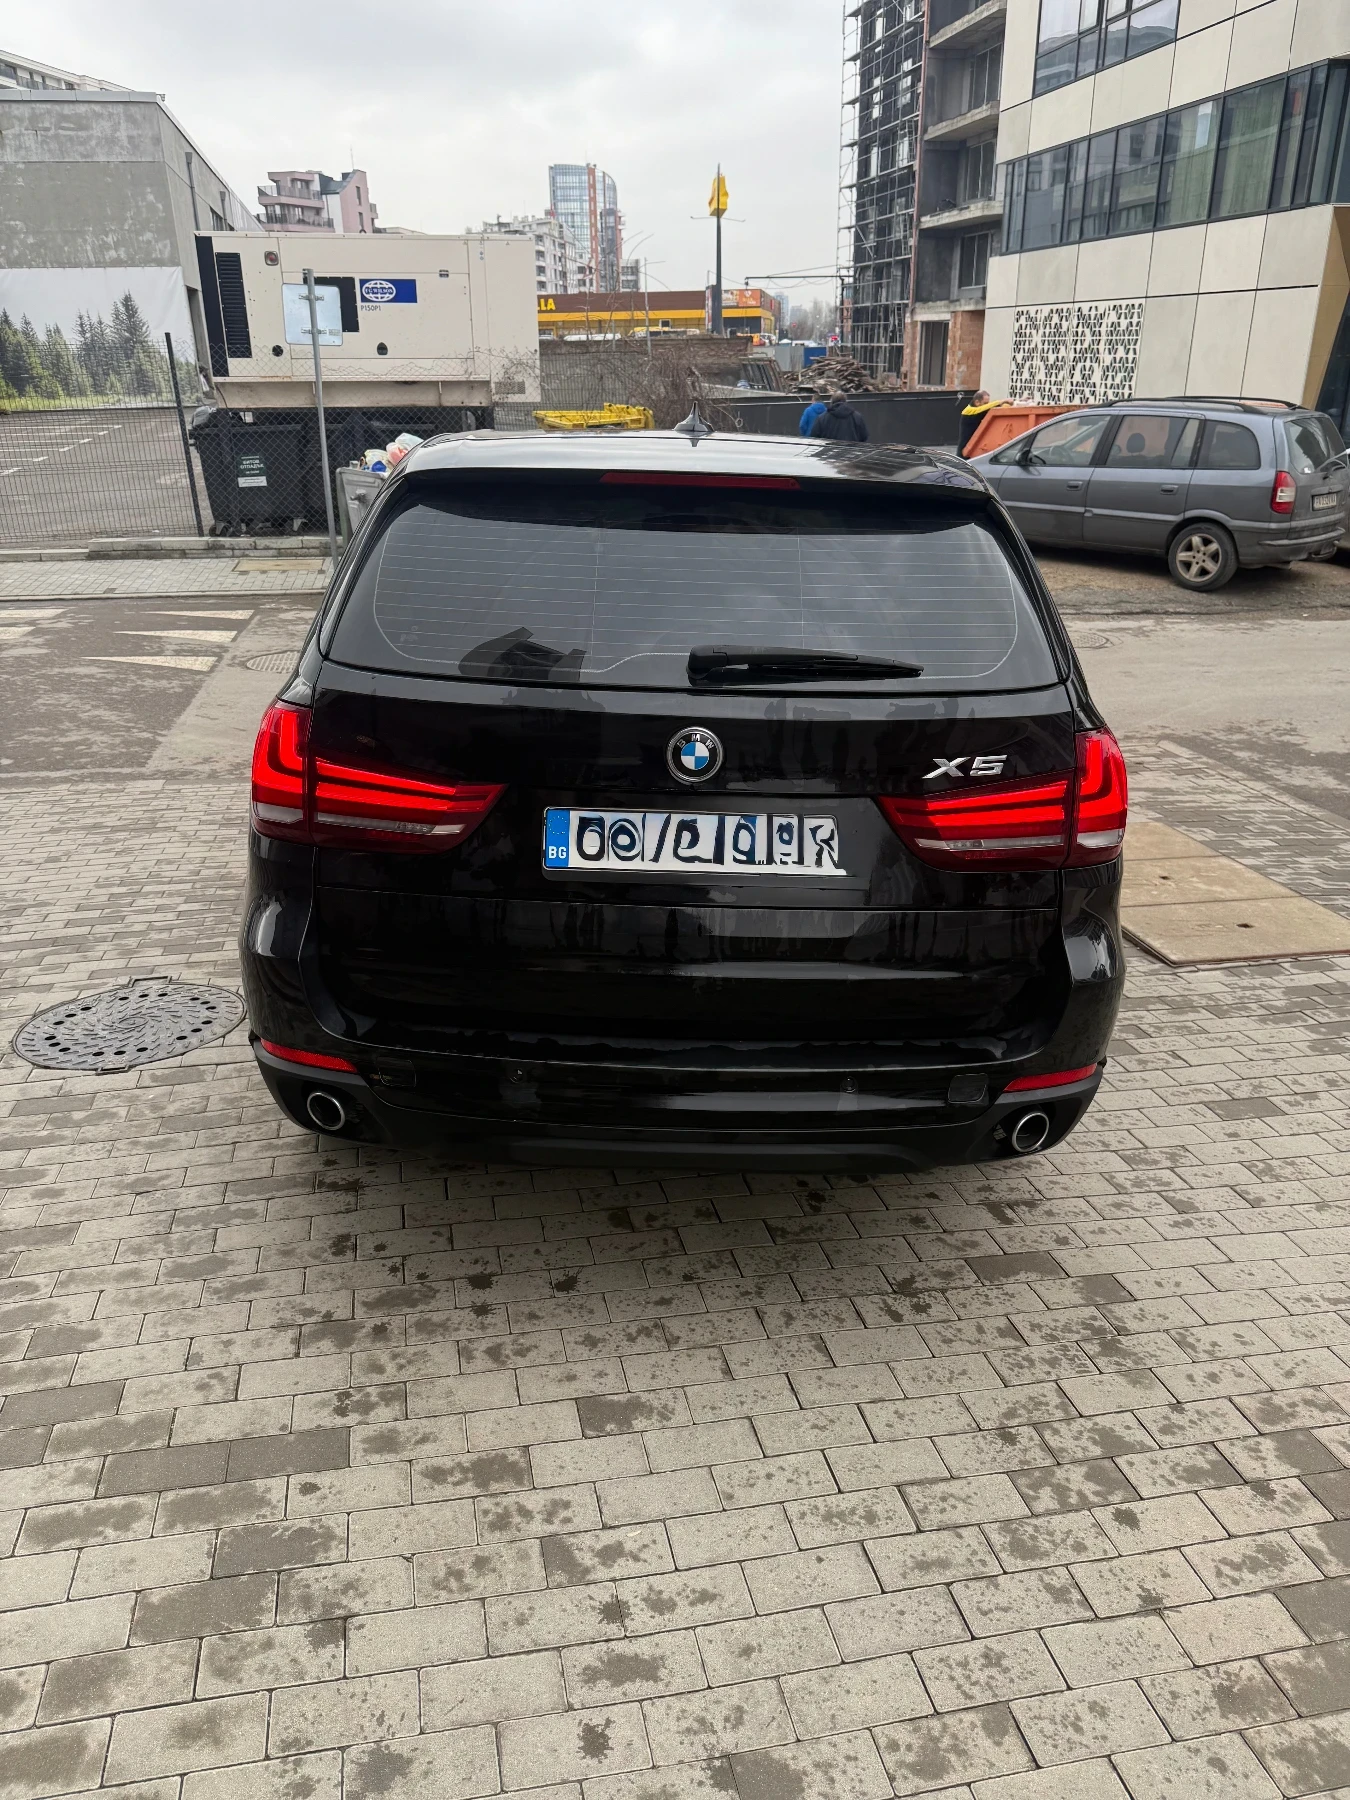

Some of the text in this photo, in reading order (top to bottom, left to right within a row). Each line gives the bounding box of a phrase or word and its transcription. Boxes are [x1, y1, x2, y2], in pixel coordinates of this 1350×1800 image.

[536, 298, 556, 311] LA
[676, 733, 715, 749] BMW
[921, 754, 1008, 779] X5
[548, 845, 567, 859] BG
